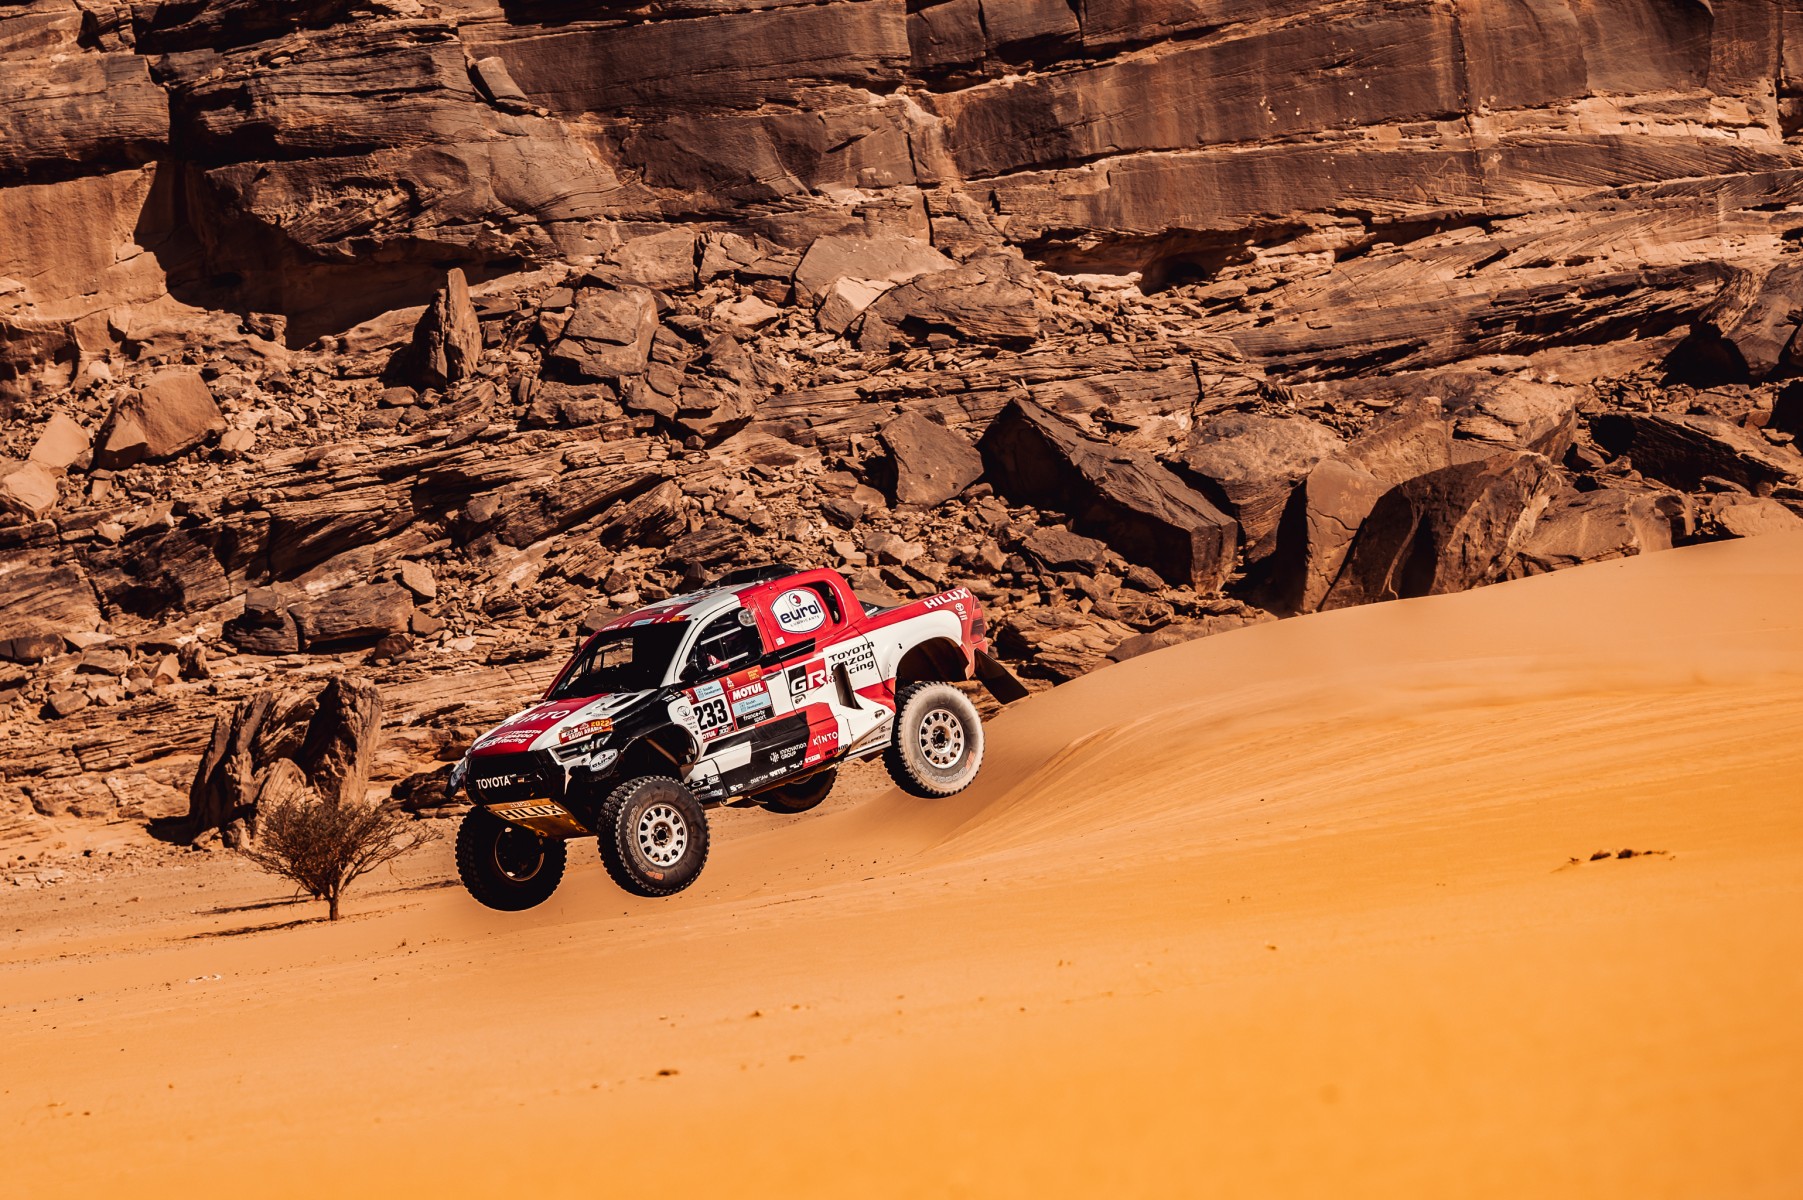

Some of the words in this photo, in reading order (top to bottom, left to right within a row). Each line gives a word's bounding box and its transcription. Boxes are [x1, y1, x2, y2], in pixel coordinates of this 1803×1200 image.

[923, 586, 970, 609] HILUX
[780, 600, 821, 624] eurol
[828, 641, 875, 662] TOYOTA
[831, 651, 873, 672] GZOO
[732, 682, 764, 701] MOTUL
[791, 669, 827, 696] GR
[591, 720, 610, 728] 2022
[693, 698, 728, 731] 233
[703, 730, 718, 740] OTUL
[812, 731, 838, 746] KINTO
[781, 750, 797, 760] GROUP
[476, 775, 511, 790] TOYOTA
[498, 804, 565, 820] HILUX
